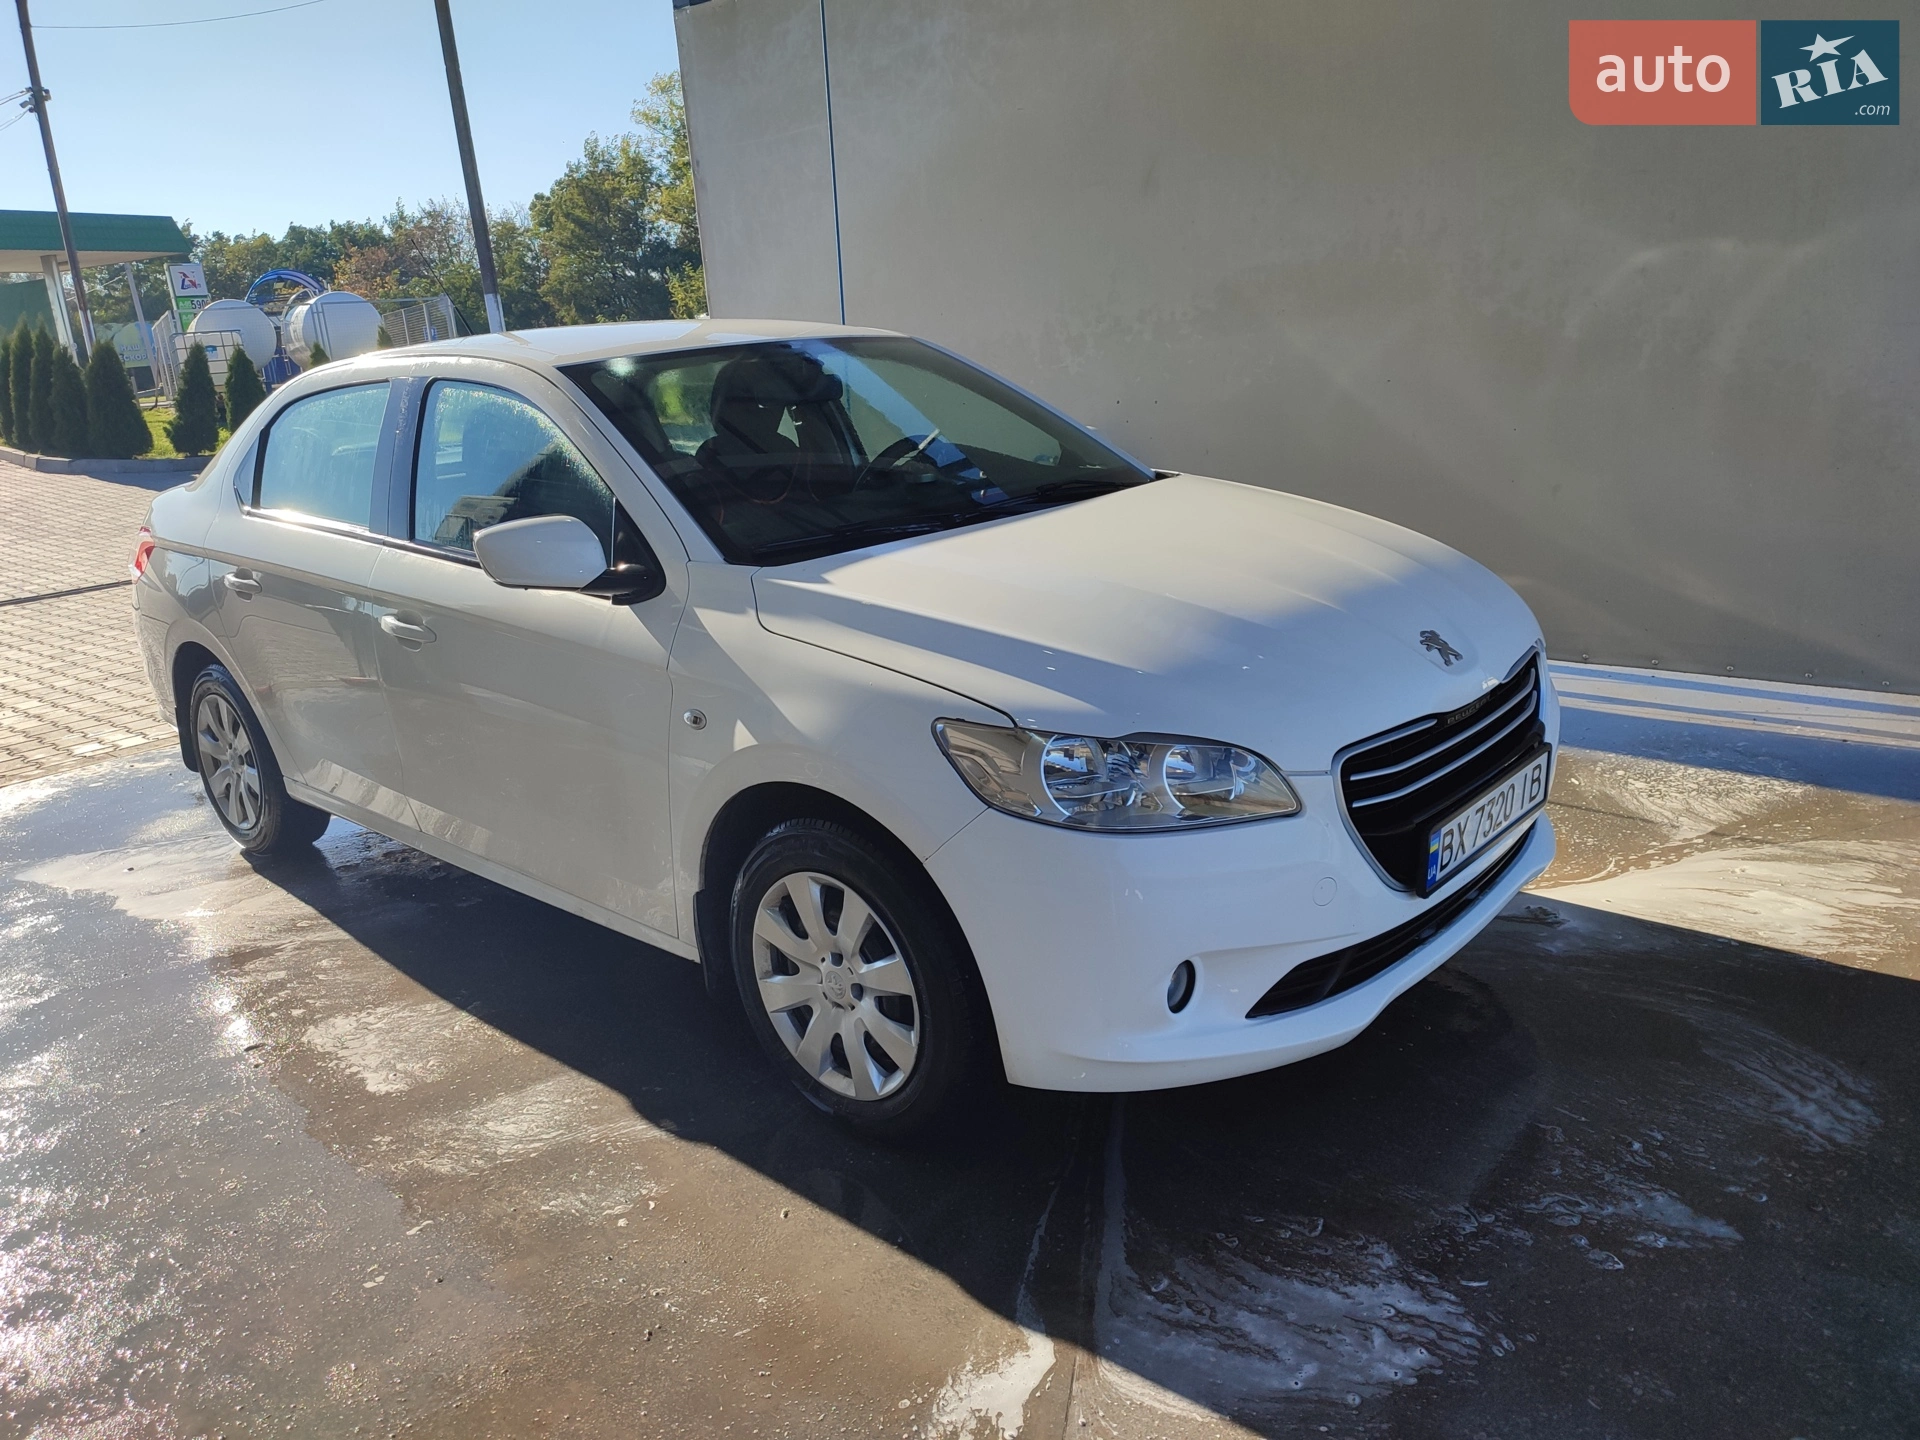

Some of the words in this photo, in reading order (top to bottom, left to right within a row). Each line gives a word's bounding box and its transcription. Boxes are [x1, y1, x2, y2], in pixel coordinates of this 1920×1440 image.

[1439, 815, 1470, 874] BX
[1471, 783, 1516, 848] 7320
[1520, 763, 1542, 811] IB
[1427, 864, 1437, 880] UA
